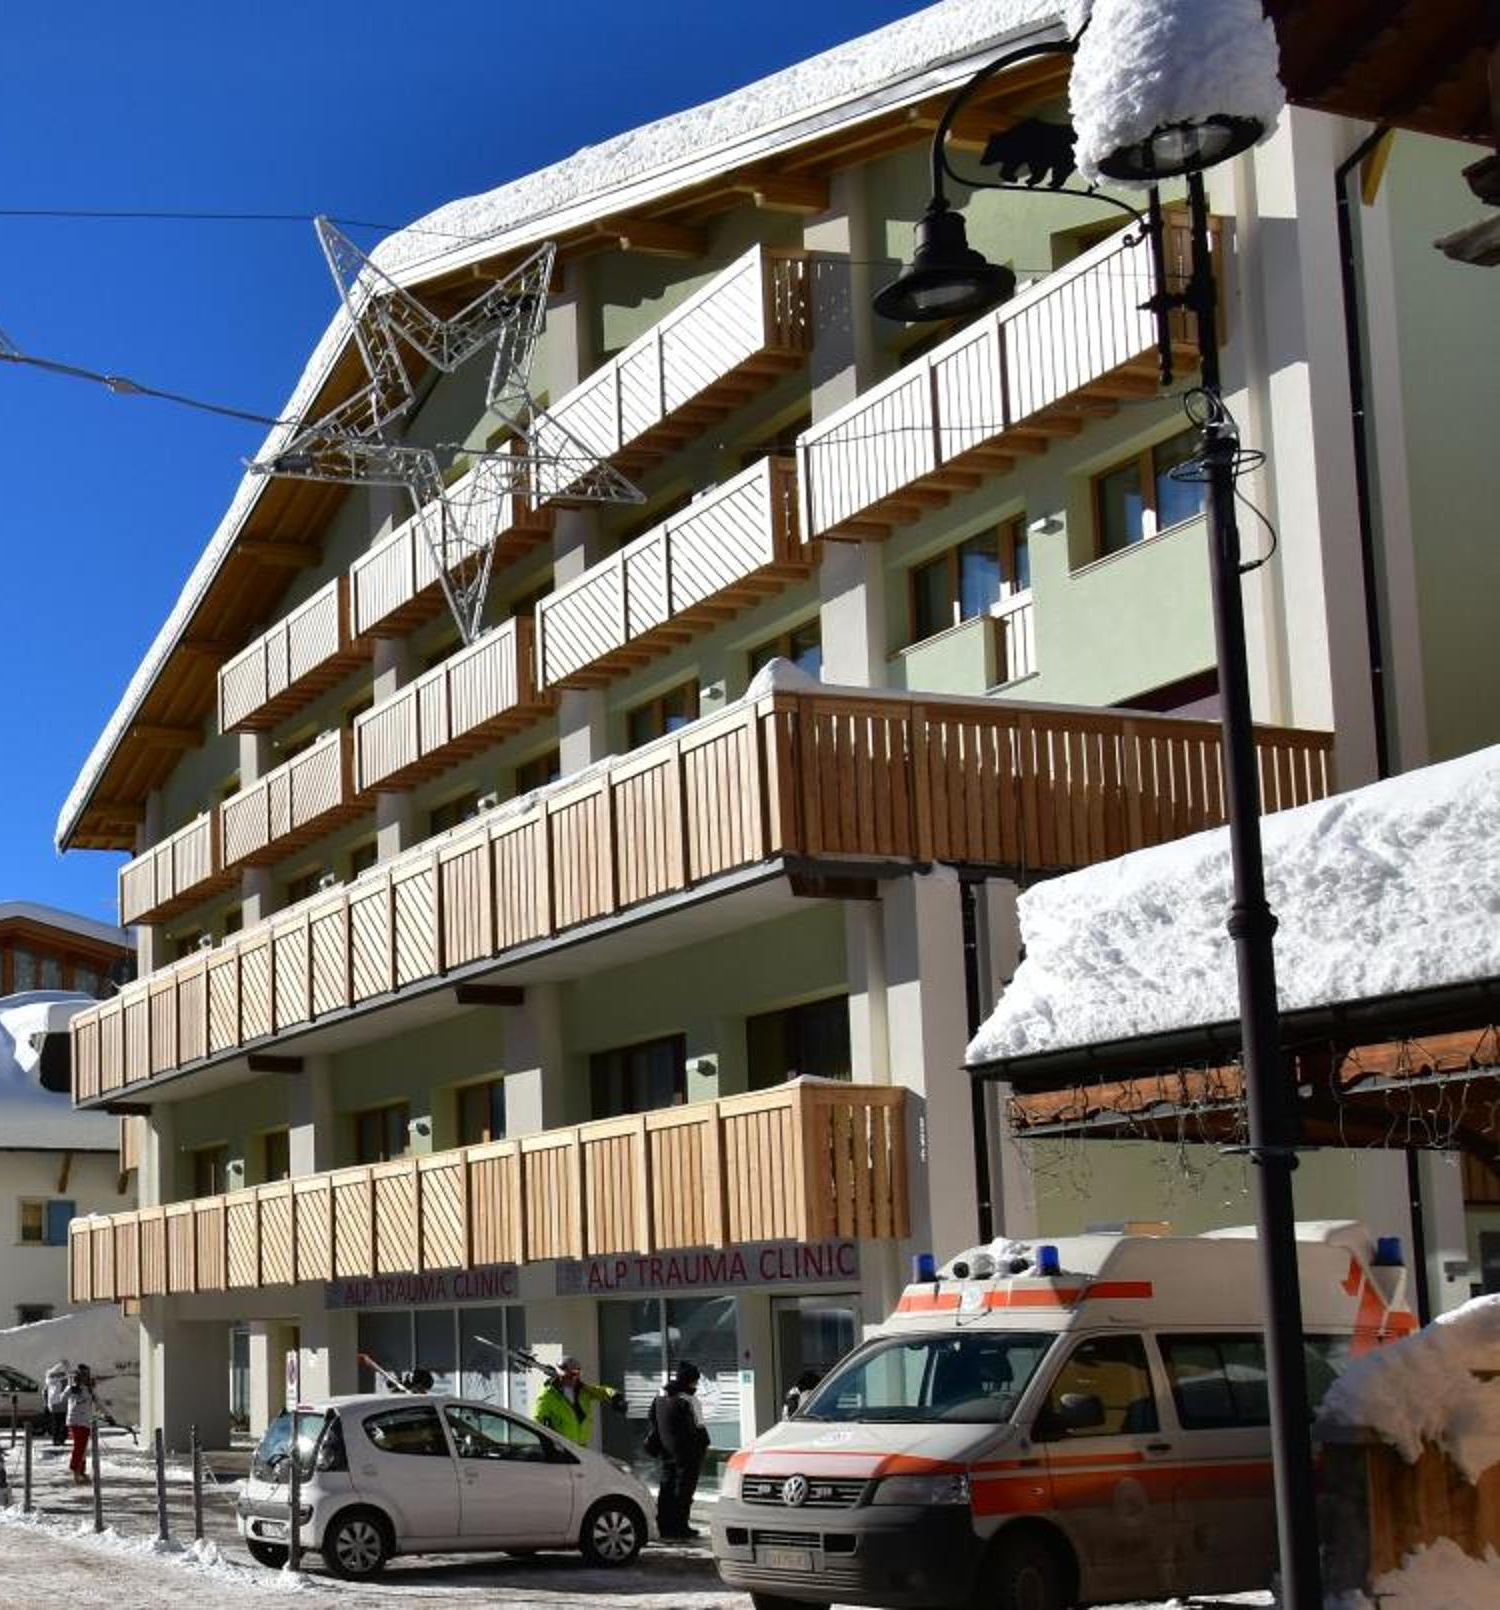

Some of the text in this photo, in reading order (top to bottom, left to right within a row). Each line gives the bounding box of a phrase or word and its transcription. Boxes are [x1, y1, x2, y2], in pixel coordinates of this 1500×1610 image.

[346, 1268, 514, 1305] ALP TRAUMA CLINIC
[588, 1243, 856, 1290] ALP TRAUMA CLINIC
